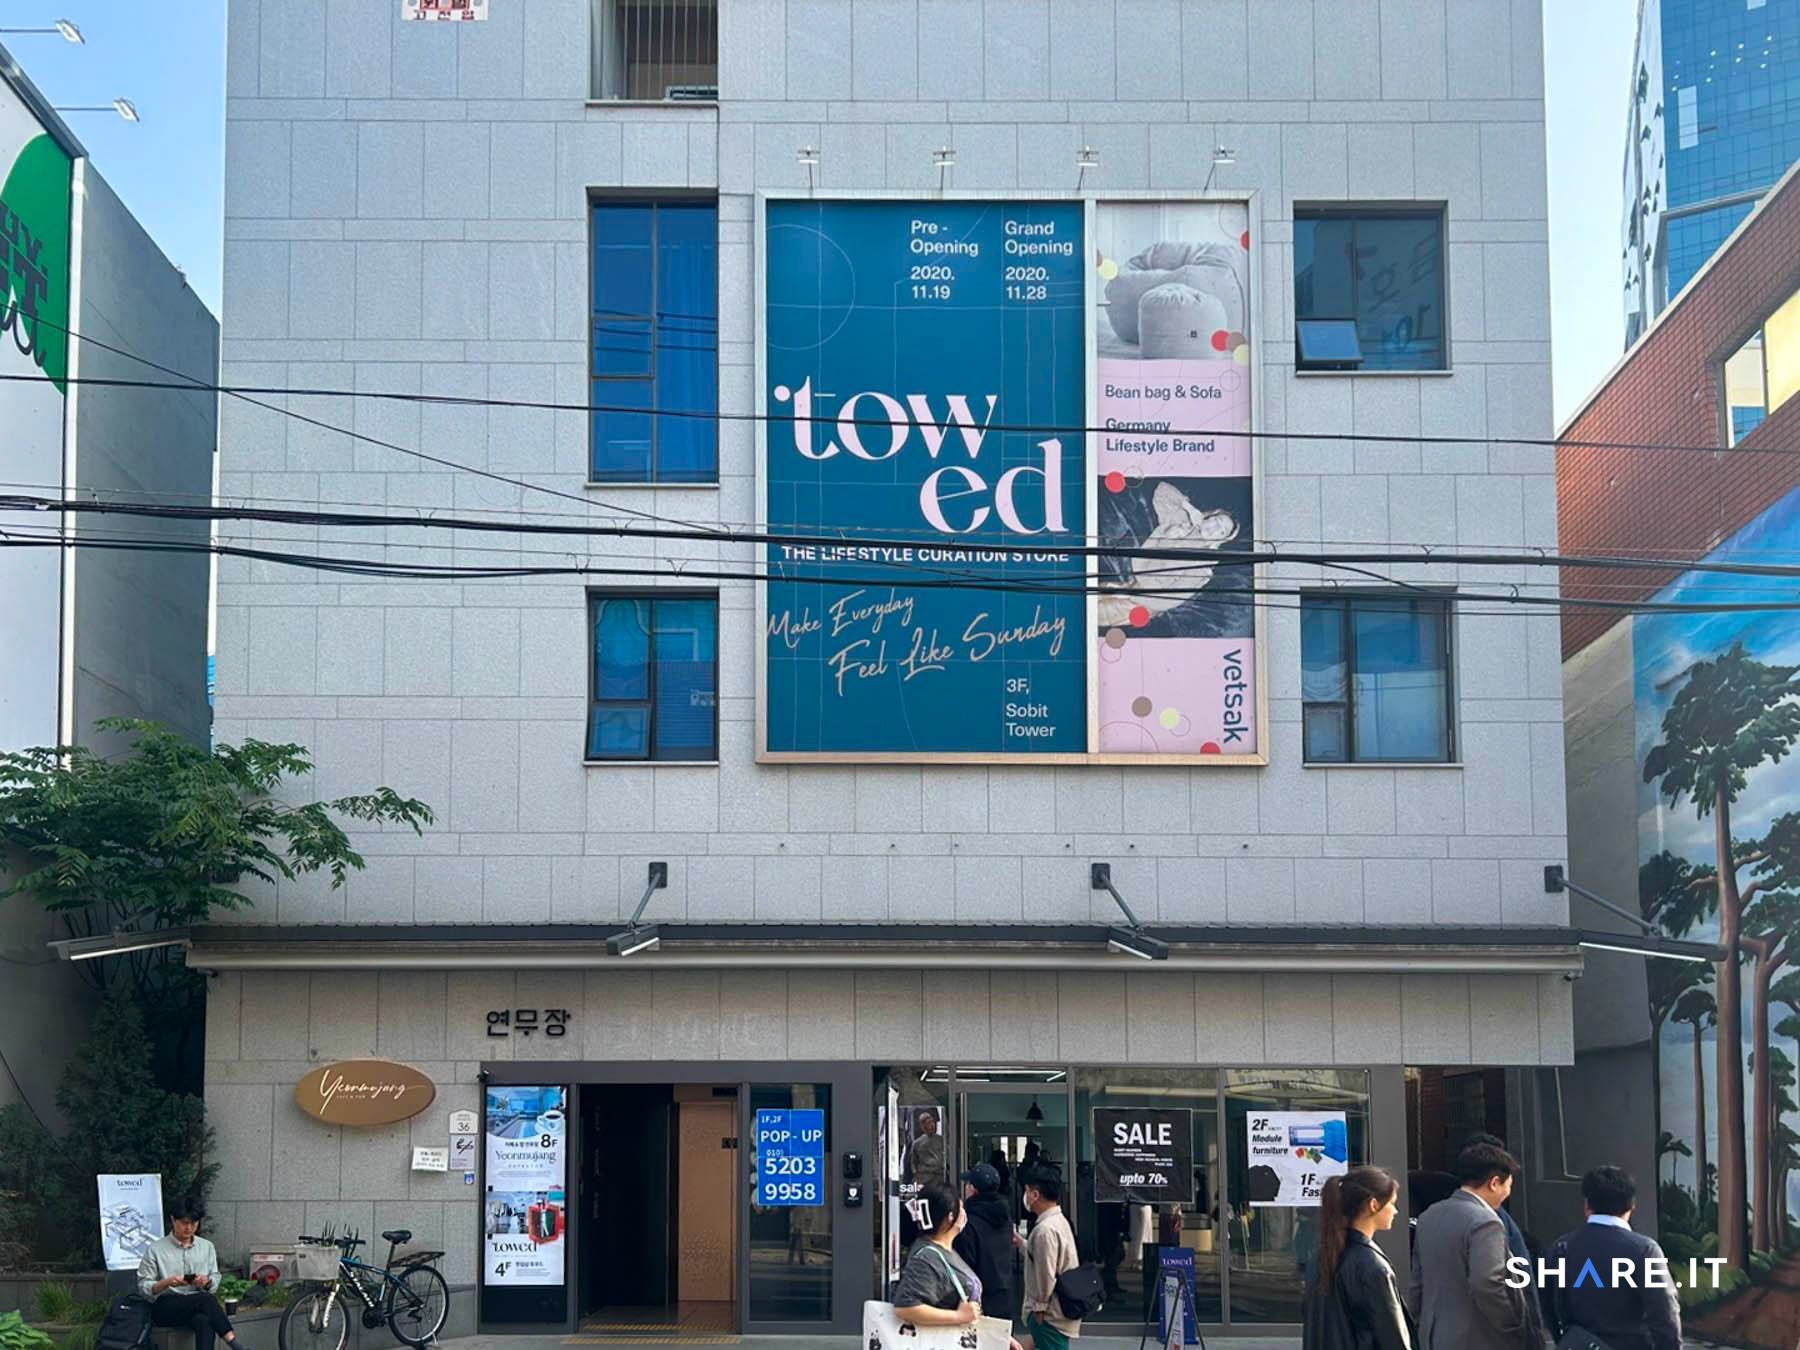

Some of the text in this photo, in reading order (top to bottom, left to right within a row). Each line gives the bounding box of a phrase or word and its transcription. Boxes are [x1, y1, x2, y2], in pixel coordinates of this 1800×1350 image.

[911, 220, 938, 235] Pre
[1005, 221, 1054, 235] Grand
[911, 239, 978, 257] Opening
[1005, 240, 1073, 256] Opening
[911, 266, 955, 280] 2020.
[1005, 267, 1050, 281] 2020.
[912, 285, 950, 299] 11.19
[1006, 286, 1047, 299] 11.28
[1105, 385, 1222, 401] Bean bag & Sofa
[1105, 418, 1171, 434] Germany
[1106, 438, 1215, 455] Lifestyle Brand
[920, 438, 1069, 534] ed
[781, 546, 815, 560] THE
[822, 546, 913, 562] LIFESTYLE
[918, 549, 1007, 562] CURATION
[768, 588, 914, 648] Make Everyday
[828, 605, 1066, 696] Feel Like Sunday
[1006, 678, 1030, 694] 3F,
[1223, 648, 1249, 744] vetsak
[1005, 703, 1049, 718] Sobit
[1005, 723, 1056, 737] Tower
[486, 1009, 572, 1036] 연무장
[457, 1122, 470, 1131] 36
[1252, 1119, 1268, 1131] 2F
[1113, 1122, 1172, 1145] SALE
[1252, 1134, 1282, 1143] Module
[1252, 1146, 1288, 1155] furniture
[765, 1158, 816, 1174] 5203
[1120, 1173, 1168, 1186] upto 70%
[1301, 1173, 1316, 1185] 1F
[765, 1183, 816, 1200] 9958
[1302, 1187, 1321, 1197] Fas
